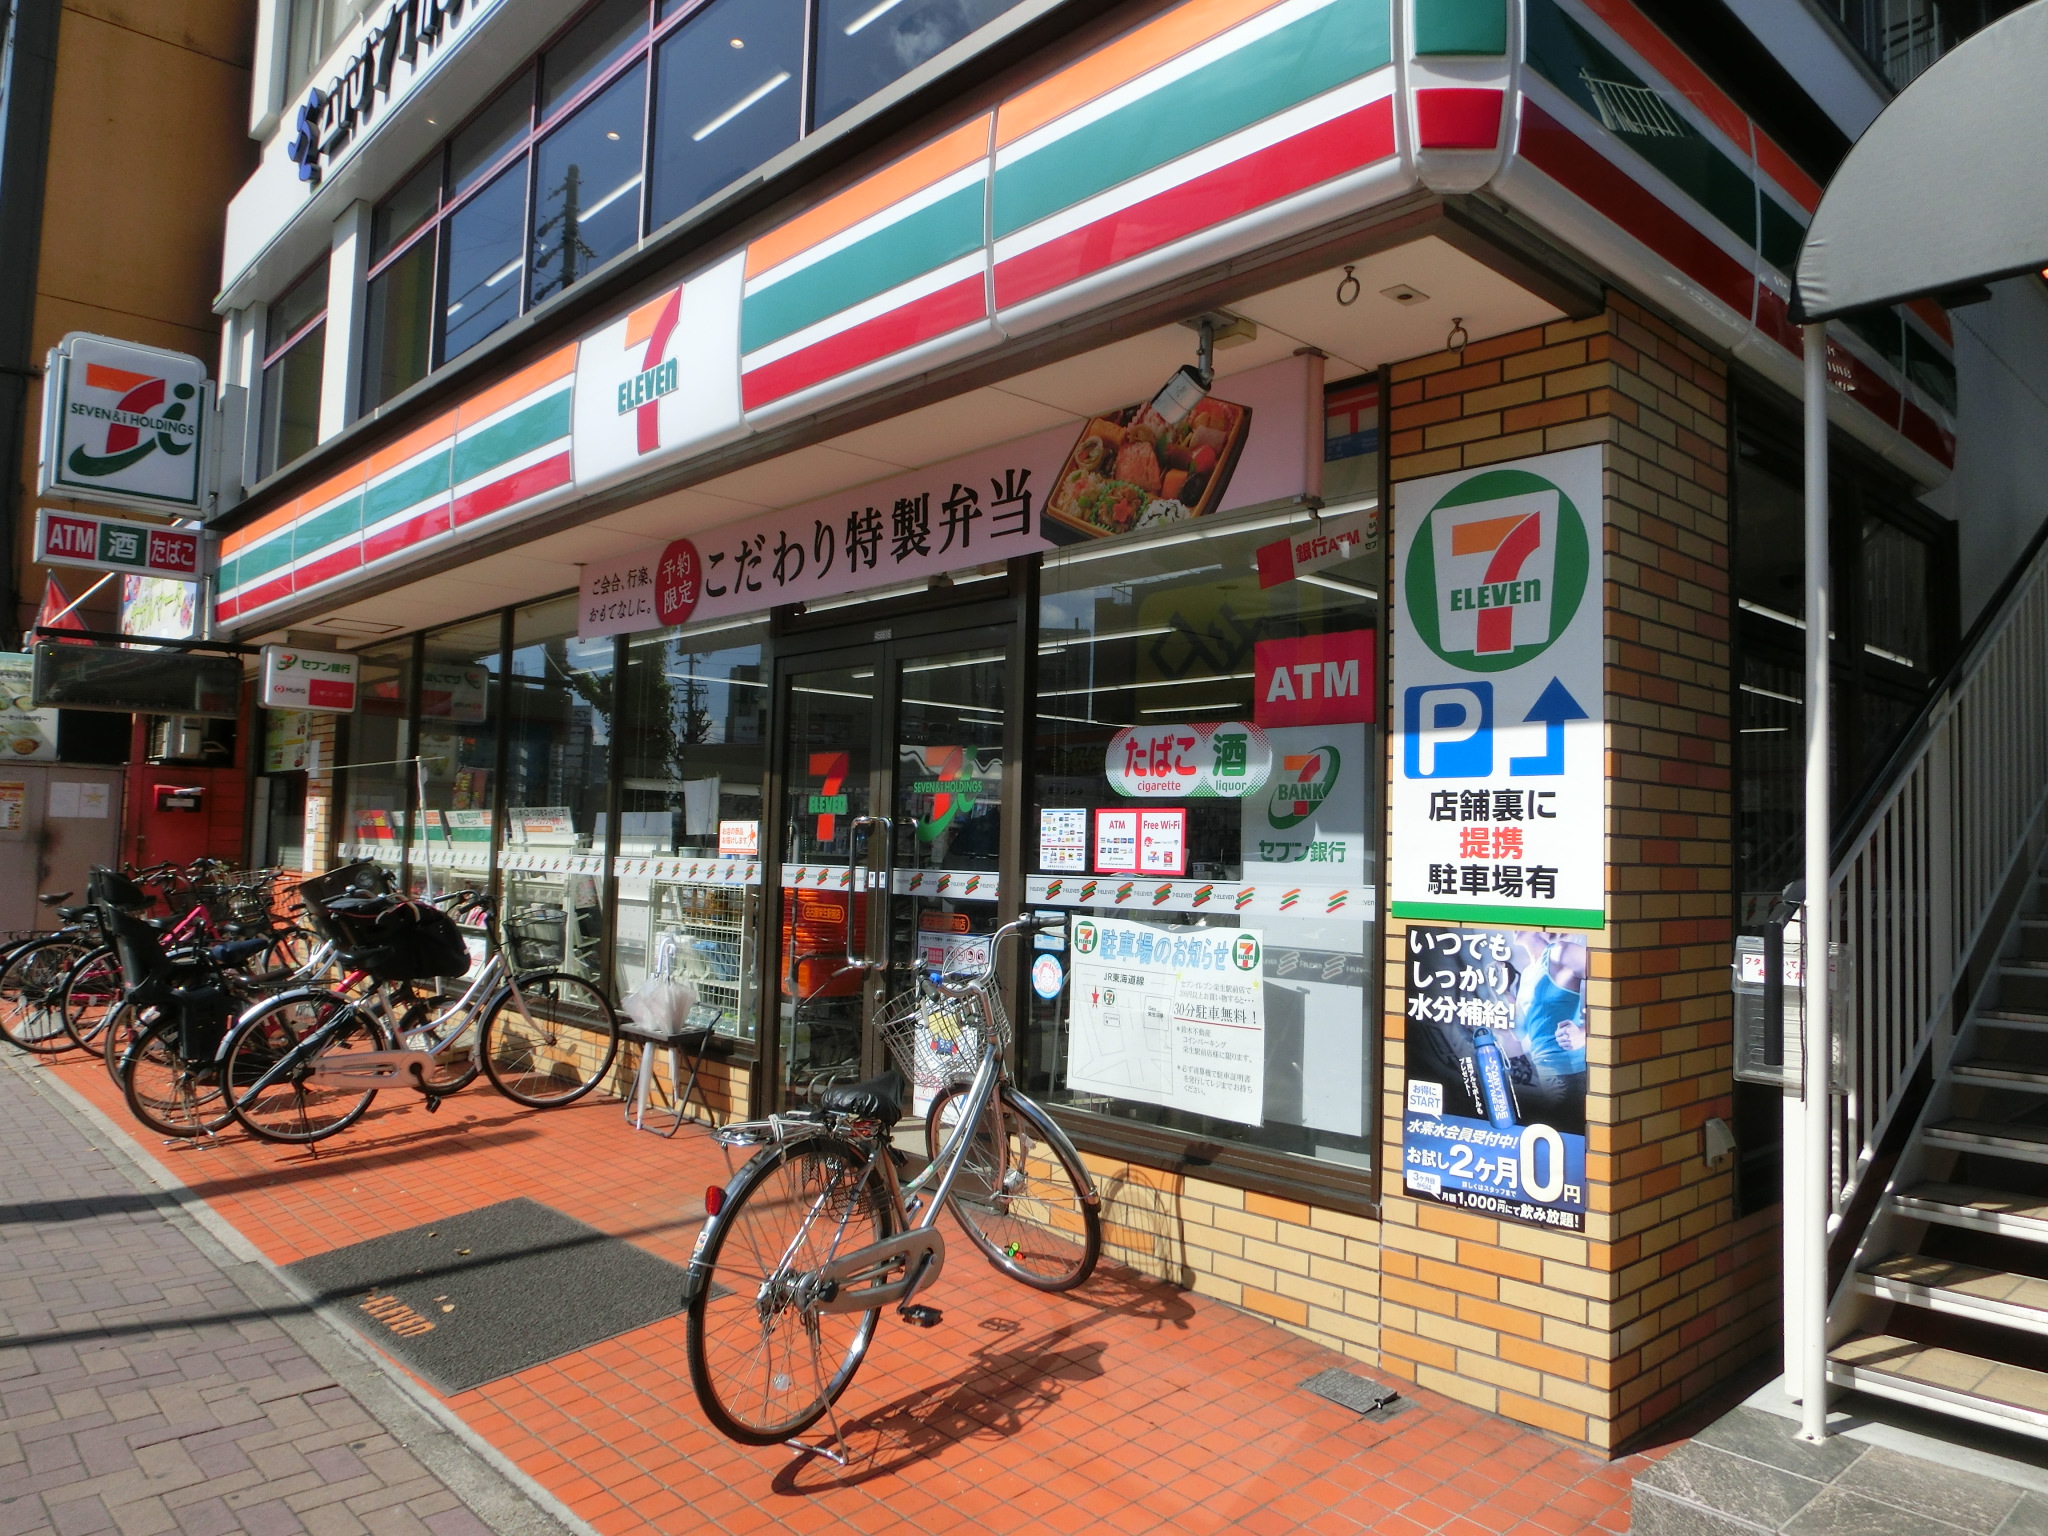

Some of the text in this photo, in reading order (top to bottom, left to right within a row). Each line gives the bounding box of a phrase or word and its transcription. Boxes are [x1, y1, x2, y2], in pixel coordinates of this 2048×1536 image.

[130, 414, 195, 436] HOLDINGS
[50, 523, 194, 567] ATM 酒 たばこ
[705, 468, 1032, 598] こだわり特製弁当
[663, 551, 690, 585] 予約
[664, 580, 694, 614] 限定
[1266, 660, 1359, 702] ATM
[1124, 734, 1197, 777] たばこ
[1212, 733, 1248, 777] 酒
[946, 781, 982, 793] HOLDINGS
[1137, 780, 1247, 794] cigarette liquor
[1278, 781, 1326, 801] BANK
[1429, 789, 1557, 822] 店舗裏に
[1109, 820, 1126, 829] ATM
[1143, 820, 1180, 830] Free Wi-Fi
[1259, 840, 1346, 863] セブン銀行
[1459, 827, 1524, 860] 提携
[1428, 863, 1558, 899] 駐車場有
[1099, 929, 1229, 971] 駐車場のお知らせ
[1410, 929, 1512, 962] いつでも
[1104, 972, 1145, 986] JR東海道線
[1413, 961, 1509, 995] しっかり
[1410, 1095, 1441, 1109] START
[1413, 1084, 1437, 1096] お得に
